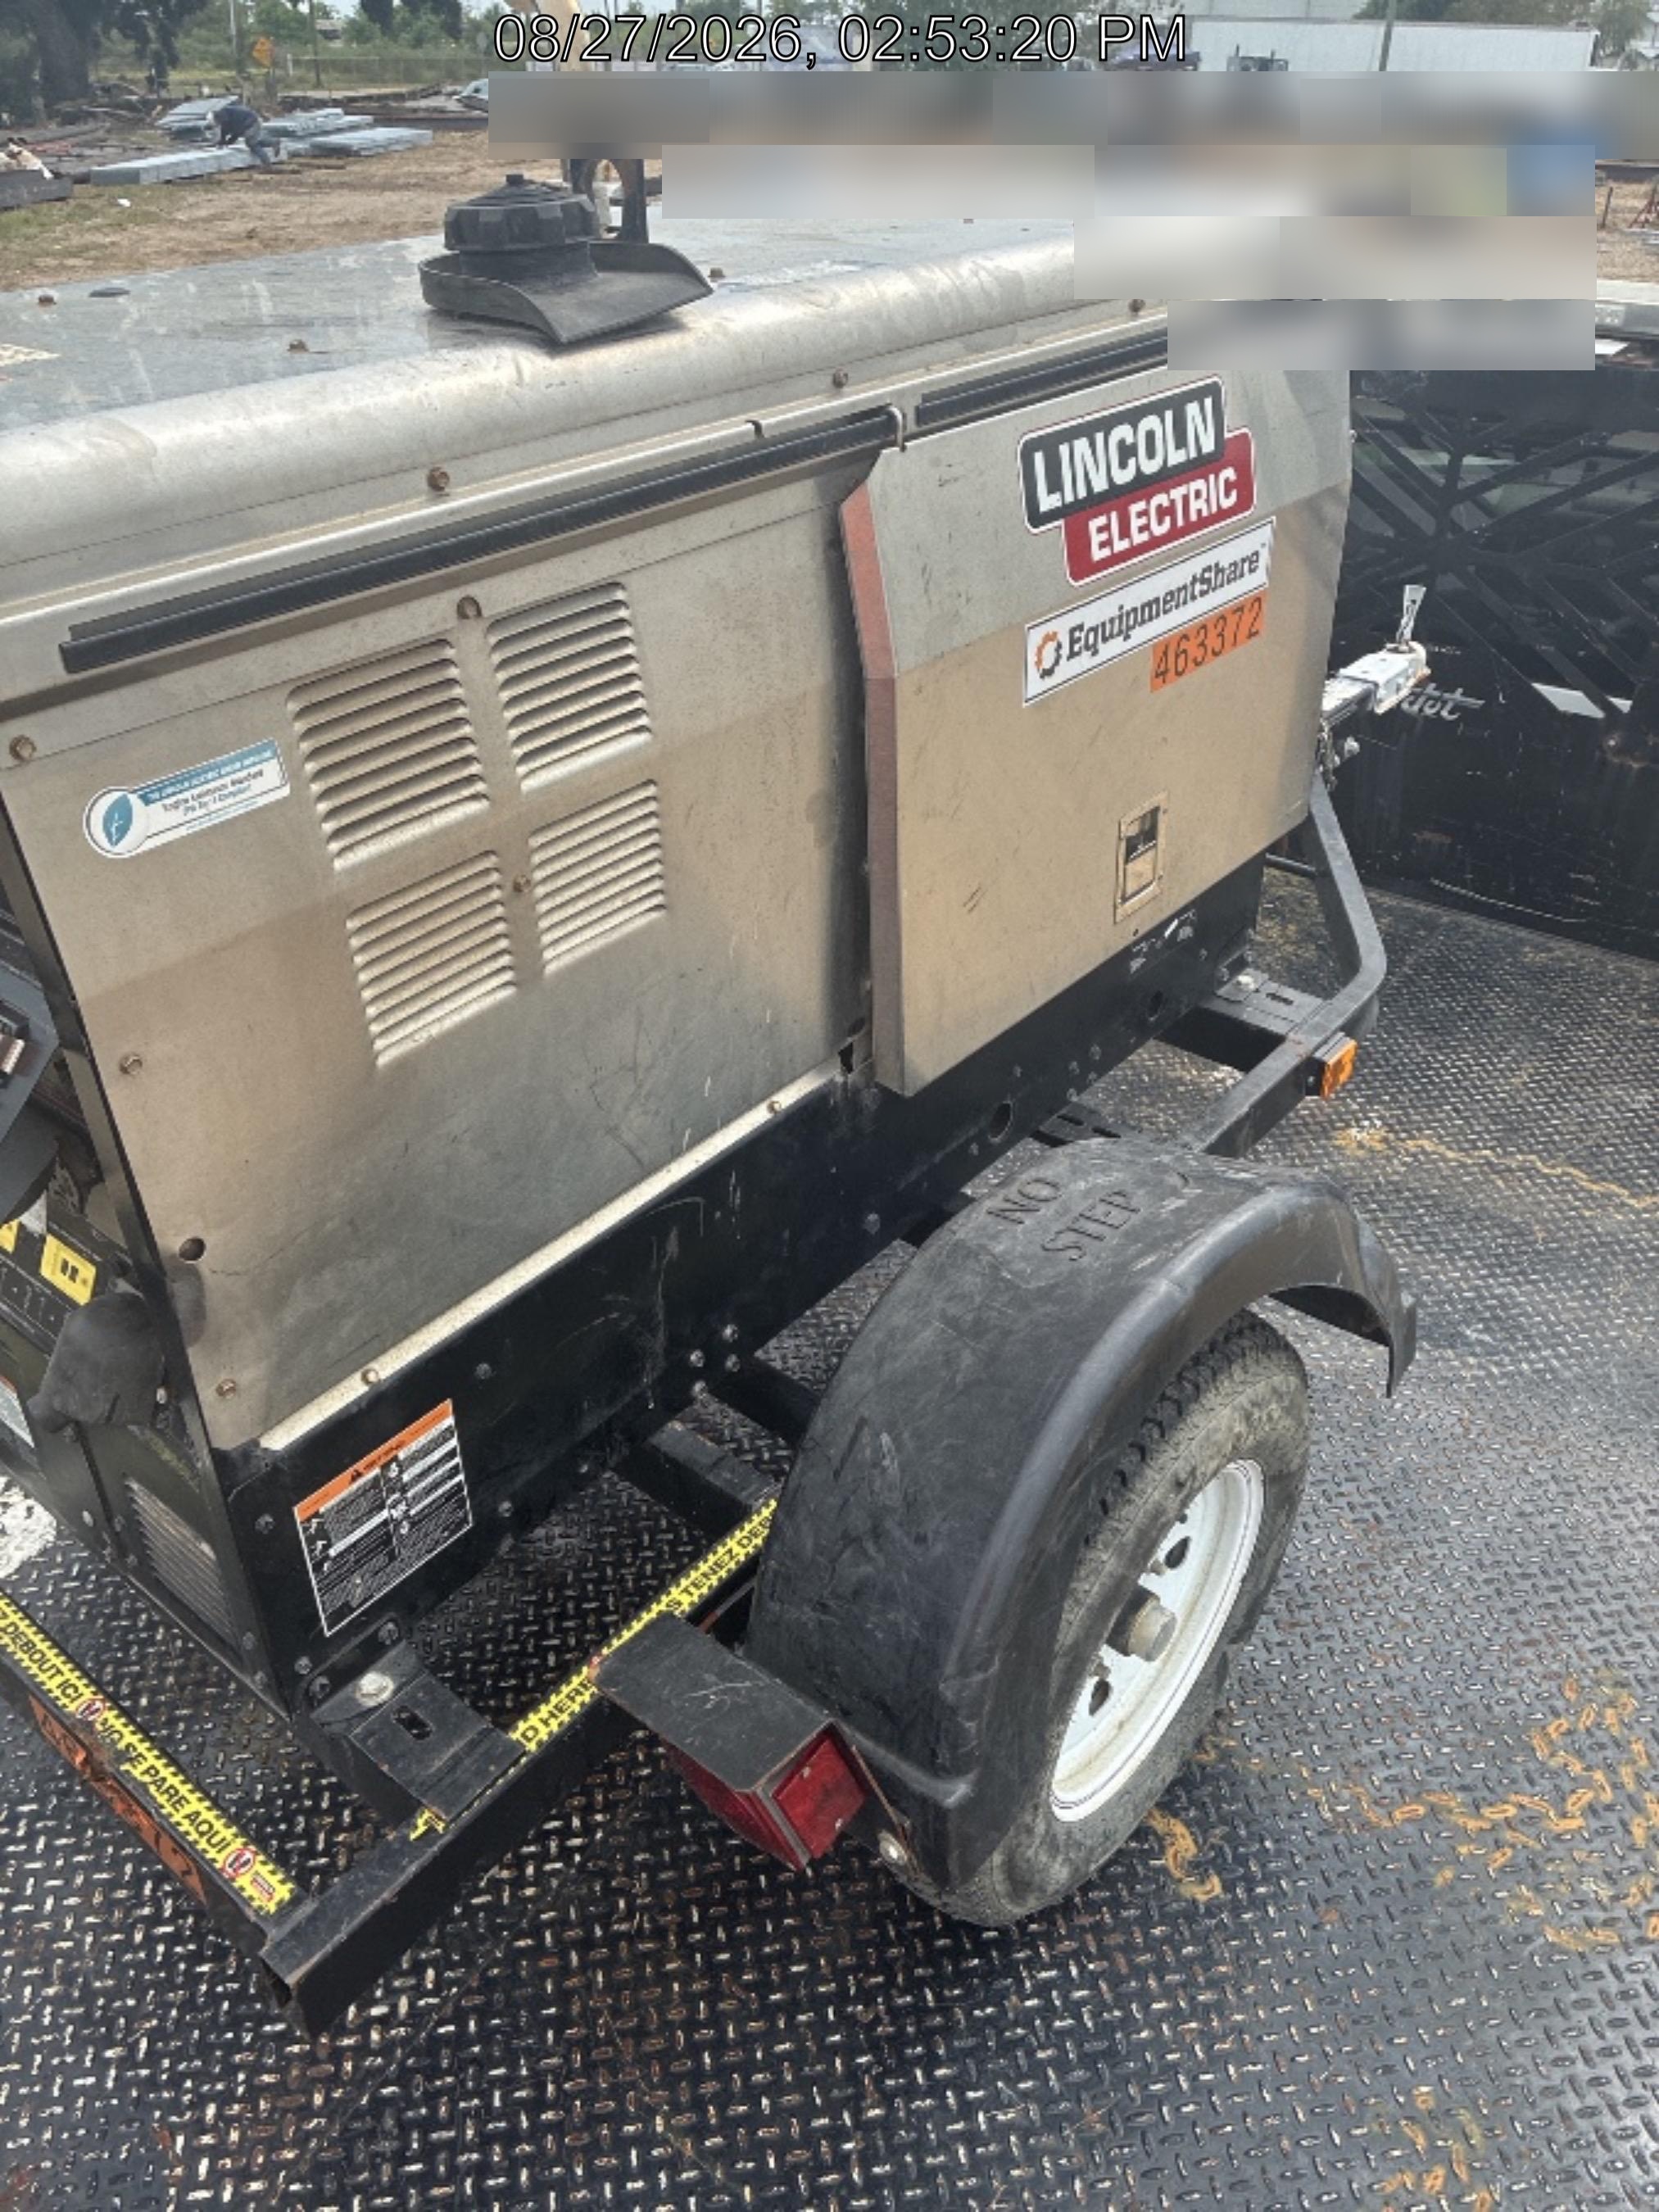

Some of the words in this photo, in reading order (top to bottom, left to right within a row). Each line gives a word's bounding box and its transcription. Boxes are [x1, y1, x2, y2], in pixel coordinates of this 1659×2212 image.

[1034, 396, 1215, 513] LINCOLN
[1088, 467, 1237, 563] ELECTRIC
[1067, 550, 1261, 662] EquipmentShare
[1154, 596, 1262, 684] 463372
[986, 1177, 1063, 1226] NO
[1040, 1190, 1141, 1262] STEP
[682, 1548, 737, 1598] TENEZ
[2, 1621, 65, 1681] DEBOUT
[56, 1678, 84, 1704] ICI
[125, 1742, 148, 1769] SE
[140, 1763, 193, 1813] PARE
